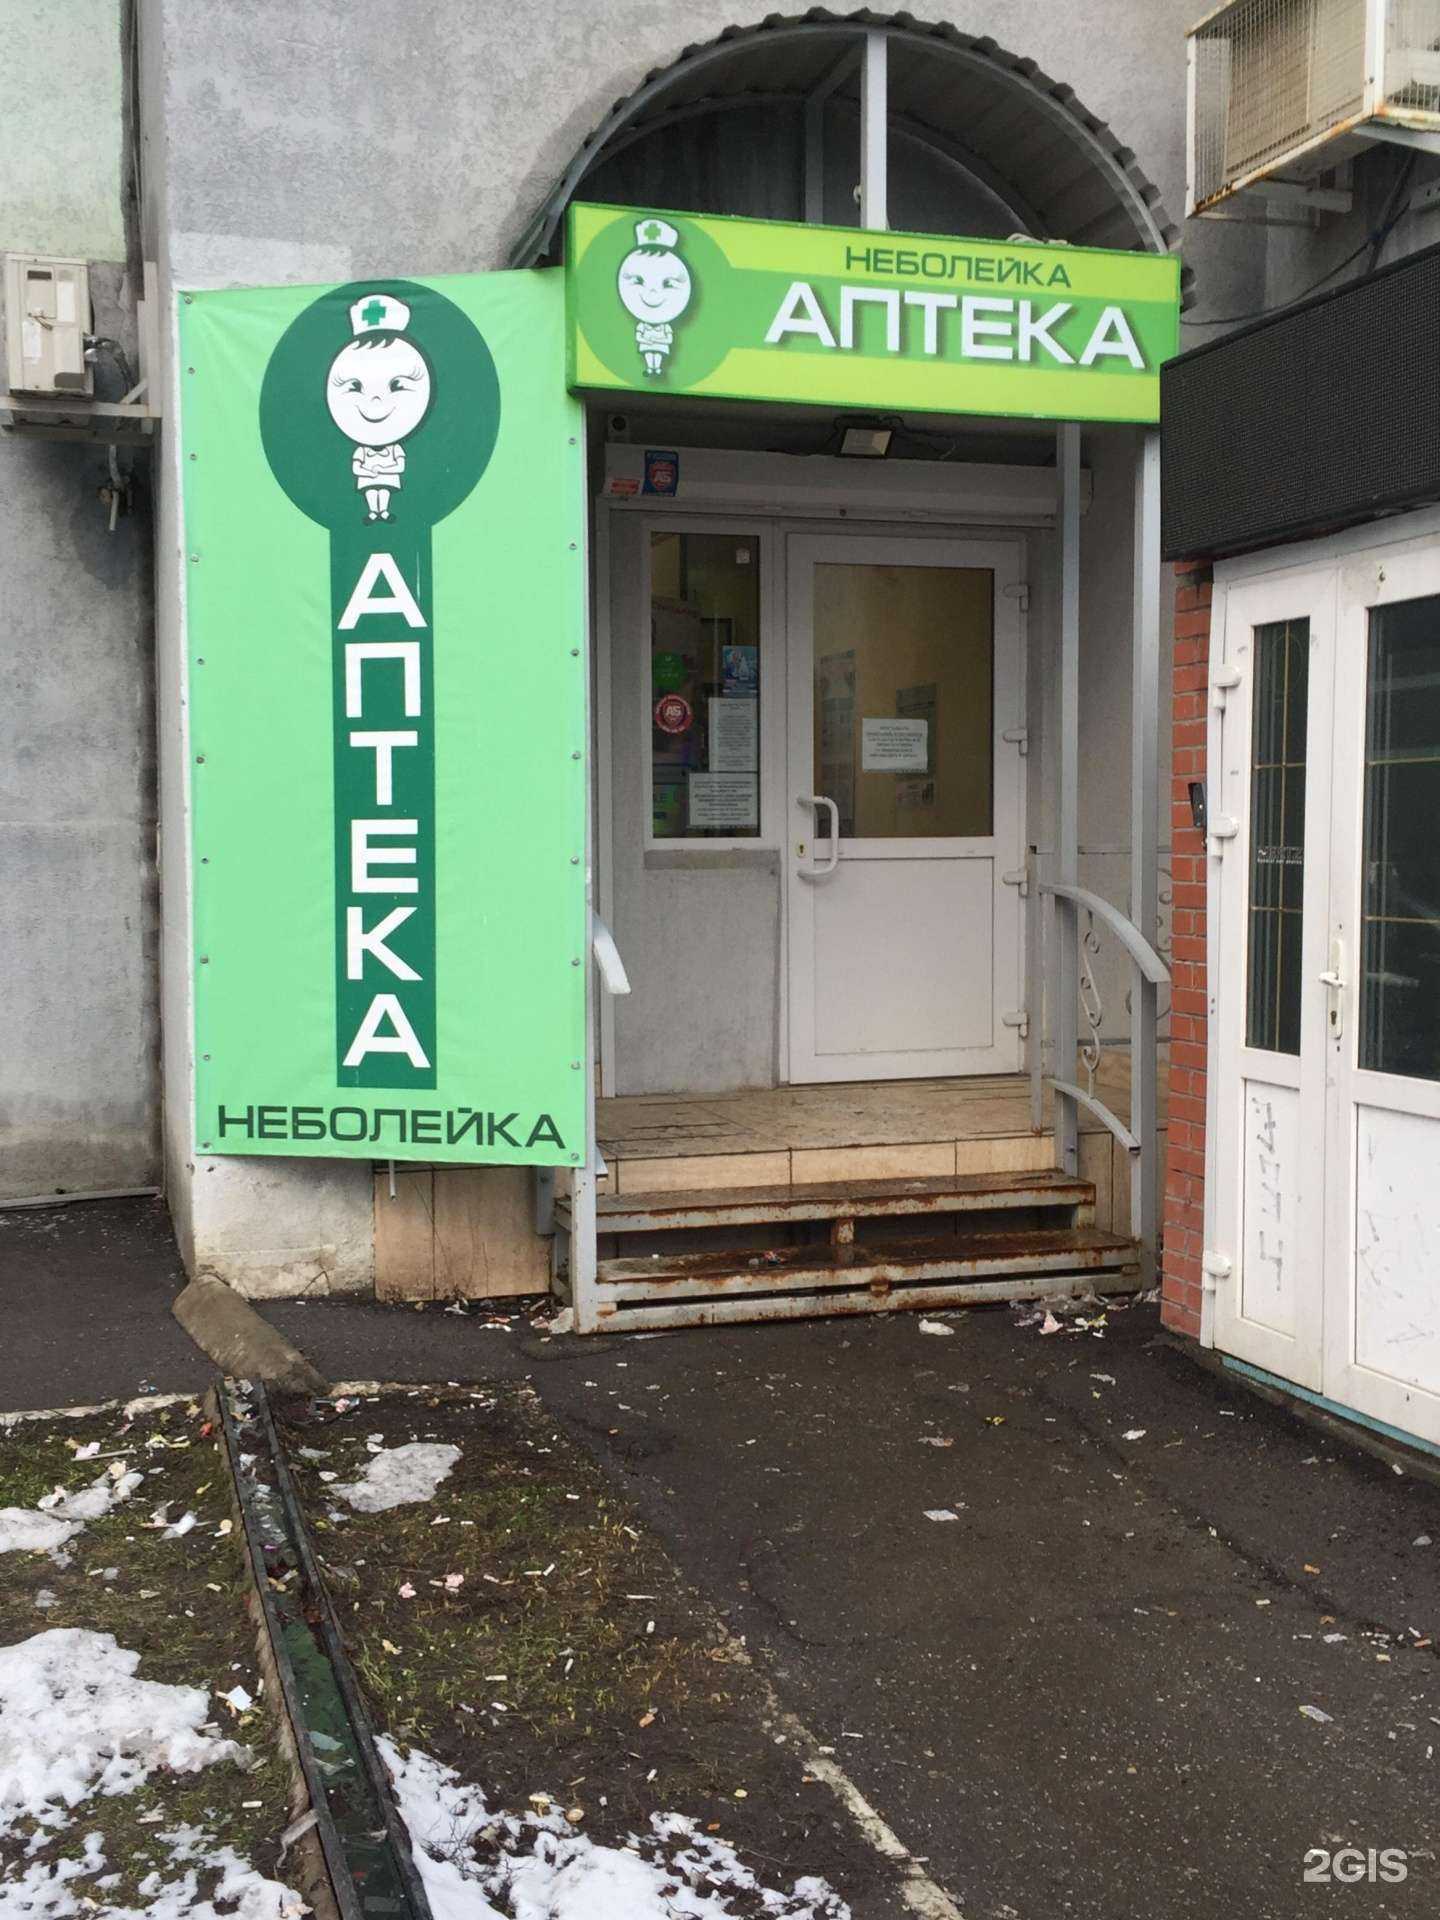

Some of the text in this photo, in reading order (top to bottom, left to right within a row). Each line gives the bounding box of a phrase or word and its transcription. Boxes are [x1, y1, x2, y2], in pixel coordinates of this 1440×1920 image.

[845, 246, 1072, 288] НЕБОЛЕЙКА
[764, 281, 1146, 369] АПТЕКА
[337, 553, 431, 1068] АПТЕКА
[217, 1104, 567, 1150] НЕБОЛЕЙКА
